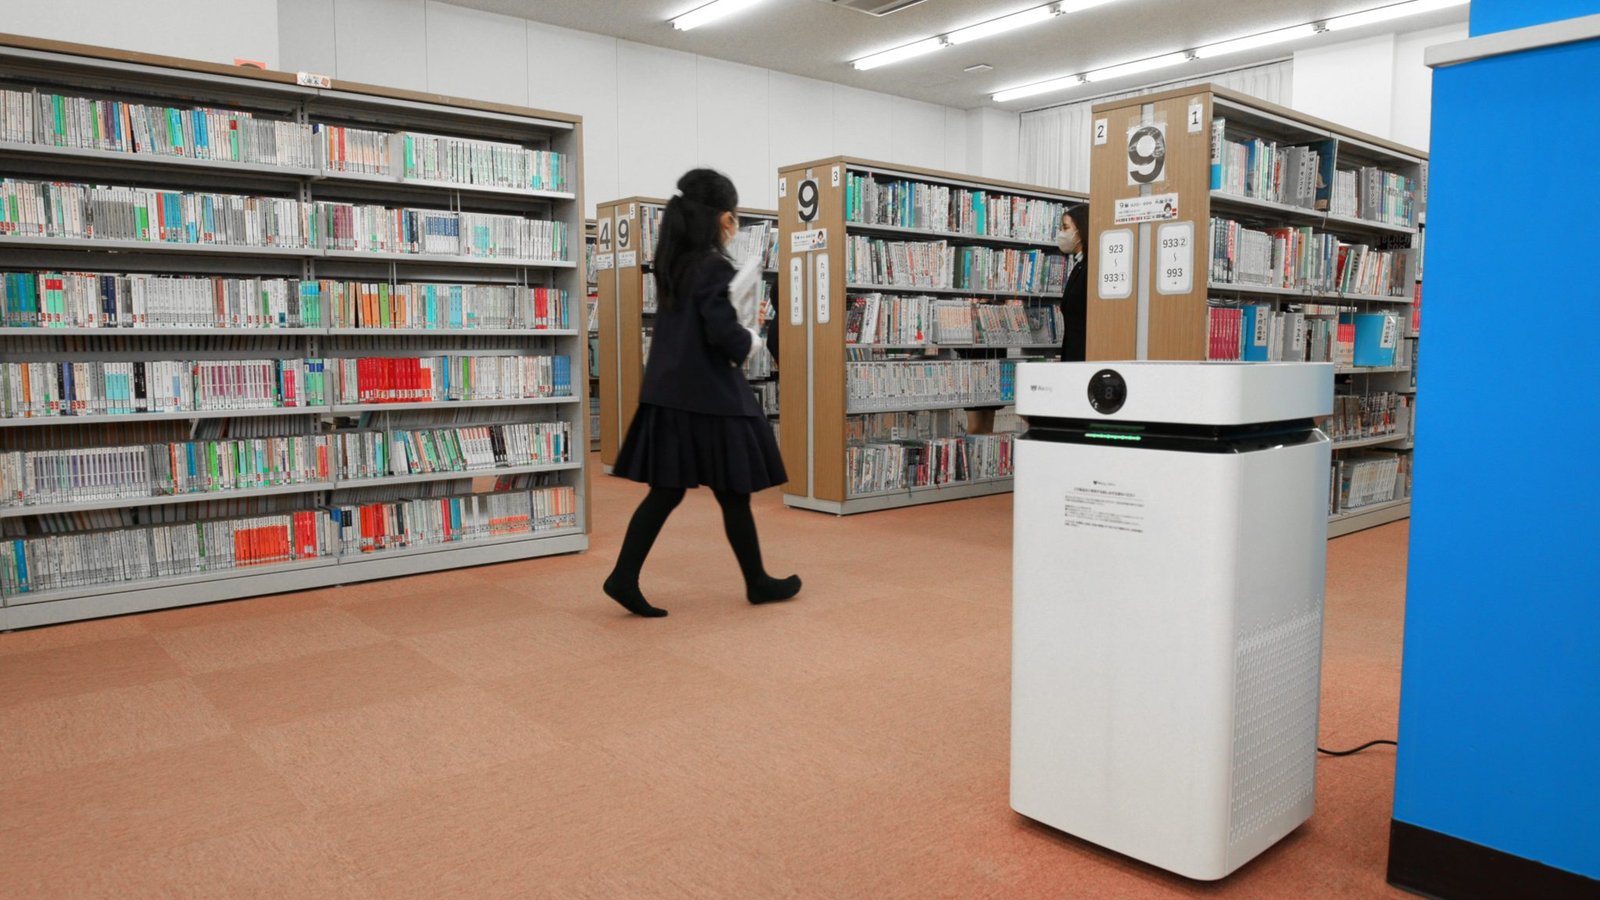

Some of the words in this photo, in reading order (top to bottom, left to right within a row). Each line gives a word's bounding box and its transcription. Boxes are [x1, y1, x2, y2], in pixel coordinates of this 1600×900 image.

[1191, 110, 1199, 125] 1
[1096, 125, 1105, 138] 2
[1128, 126, 1165, 183] 9
[833, 171, 838, 182] 3
[798, 180, 818, 222] 9
[600, 222, 611, 249] 4
[618, 219, 629, 248] 9
[1108, 244, 1124, 254] 923
[1166, 268, 1183, 278] 993
